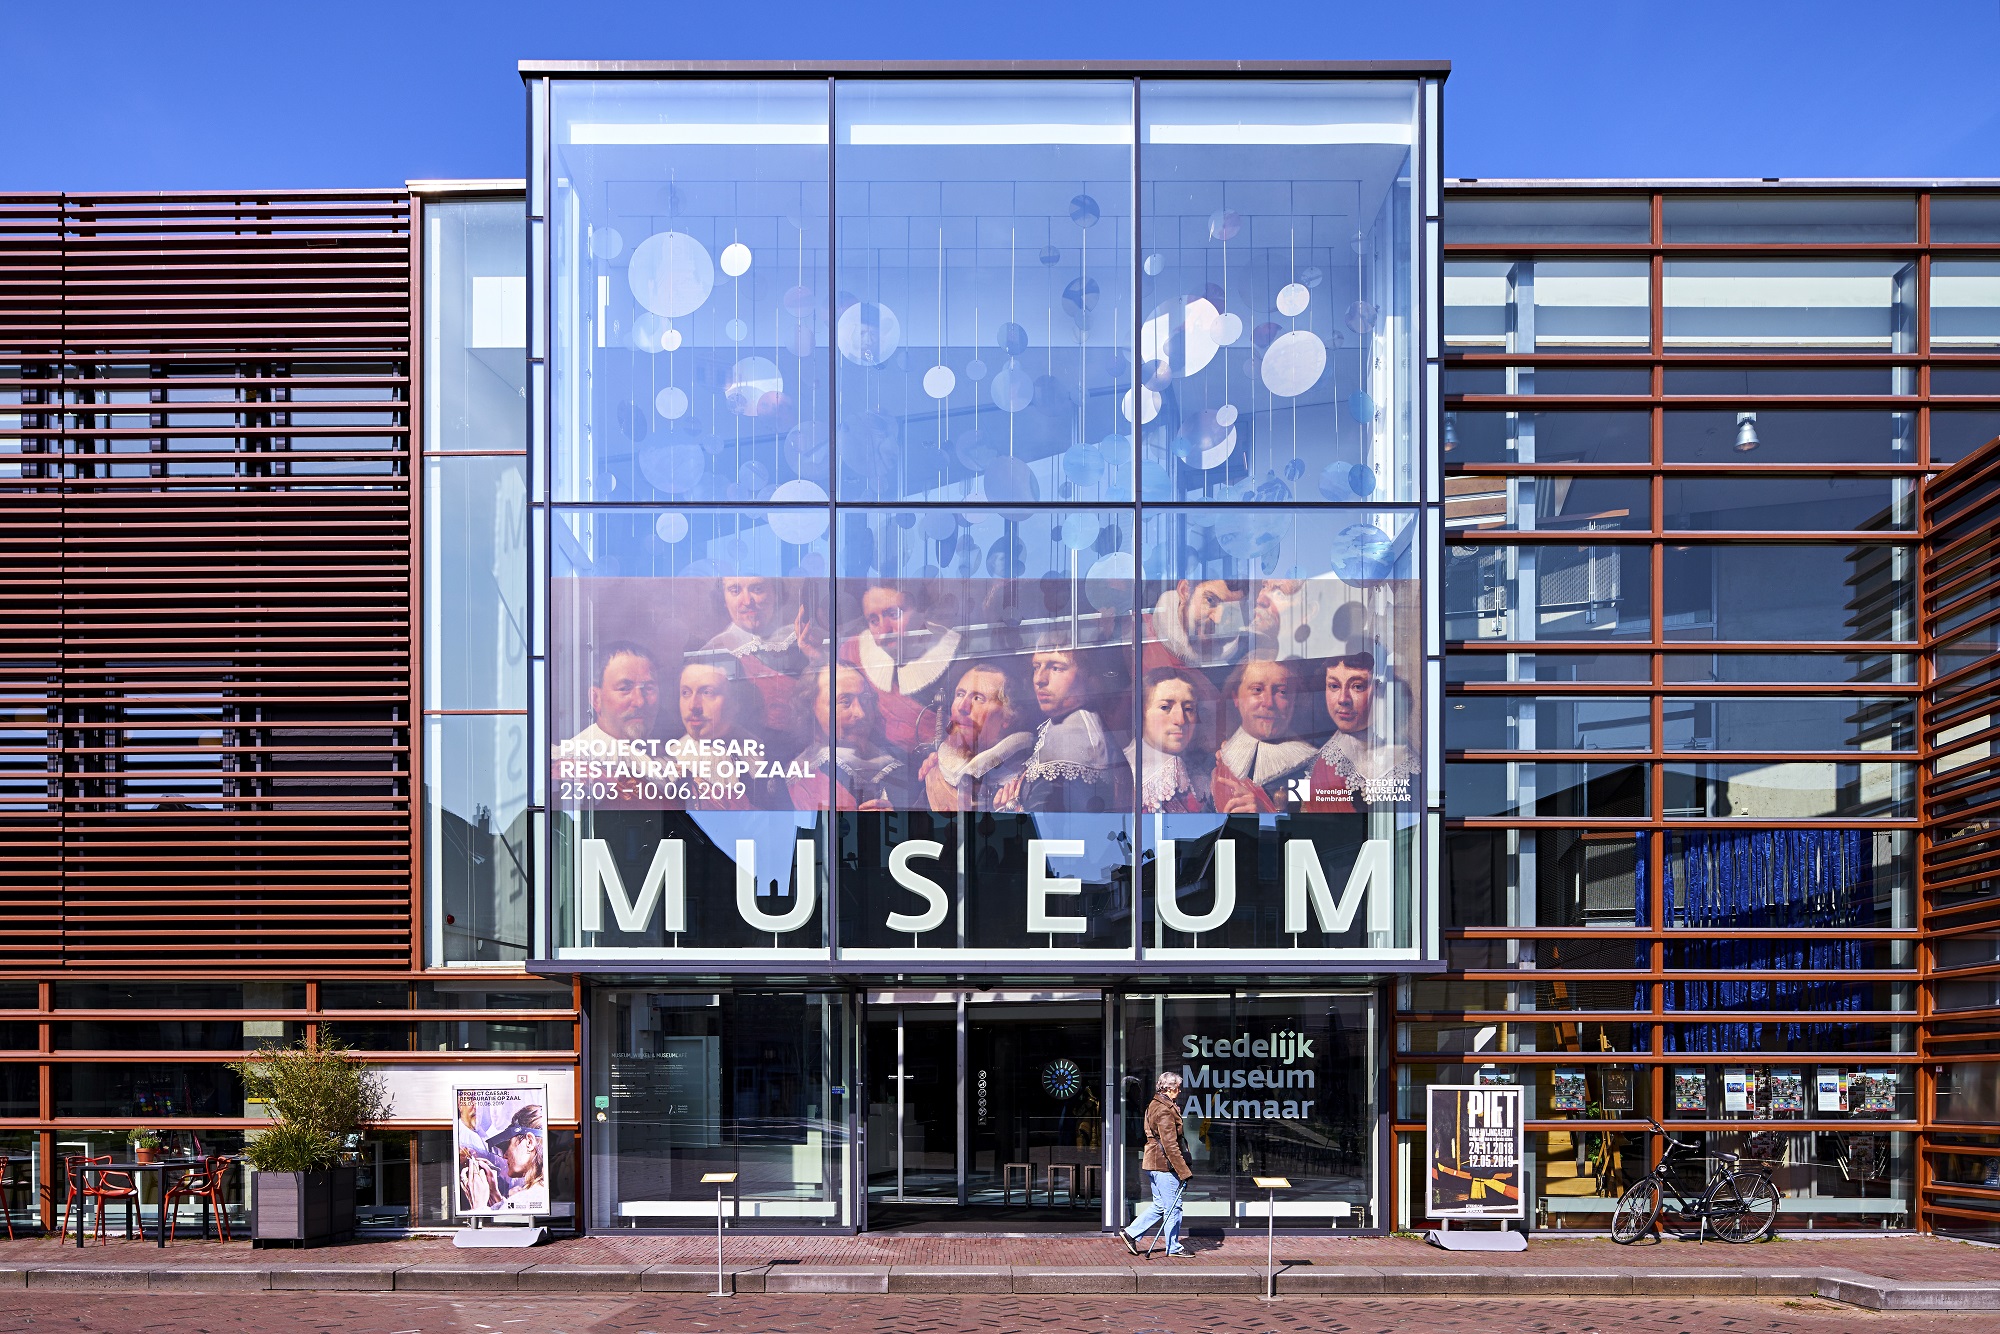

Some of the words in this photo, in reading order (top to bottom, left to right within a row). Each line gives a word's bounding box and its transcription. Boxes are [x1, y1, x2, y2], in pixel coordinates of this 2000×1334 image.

[560, 739, 660, 757] PROJECT
[665, 739, 765, 757] CAESAR:
[560, 761, 712, 778] RESTAURATIE
[717, 761, 749, 778] OP
[755, 761, 815, 778] ZAAL
[1315, 788, 1352, 796] Vereniging
[1365, 794, 1411, 802] ALKMAAR
[581, 838, 1393, 935] MUSEUM
[1182, 1030, 1315, 1065] Stedelijk
[1182, 1064, 1315, 1089] Museum
[1181, 1094, 1315, 1119] Alkmaar
[1468, 1091, 1517, 1128] PIET
[1468, 1142, 1514, 1155] 24.11.2018
